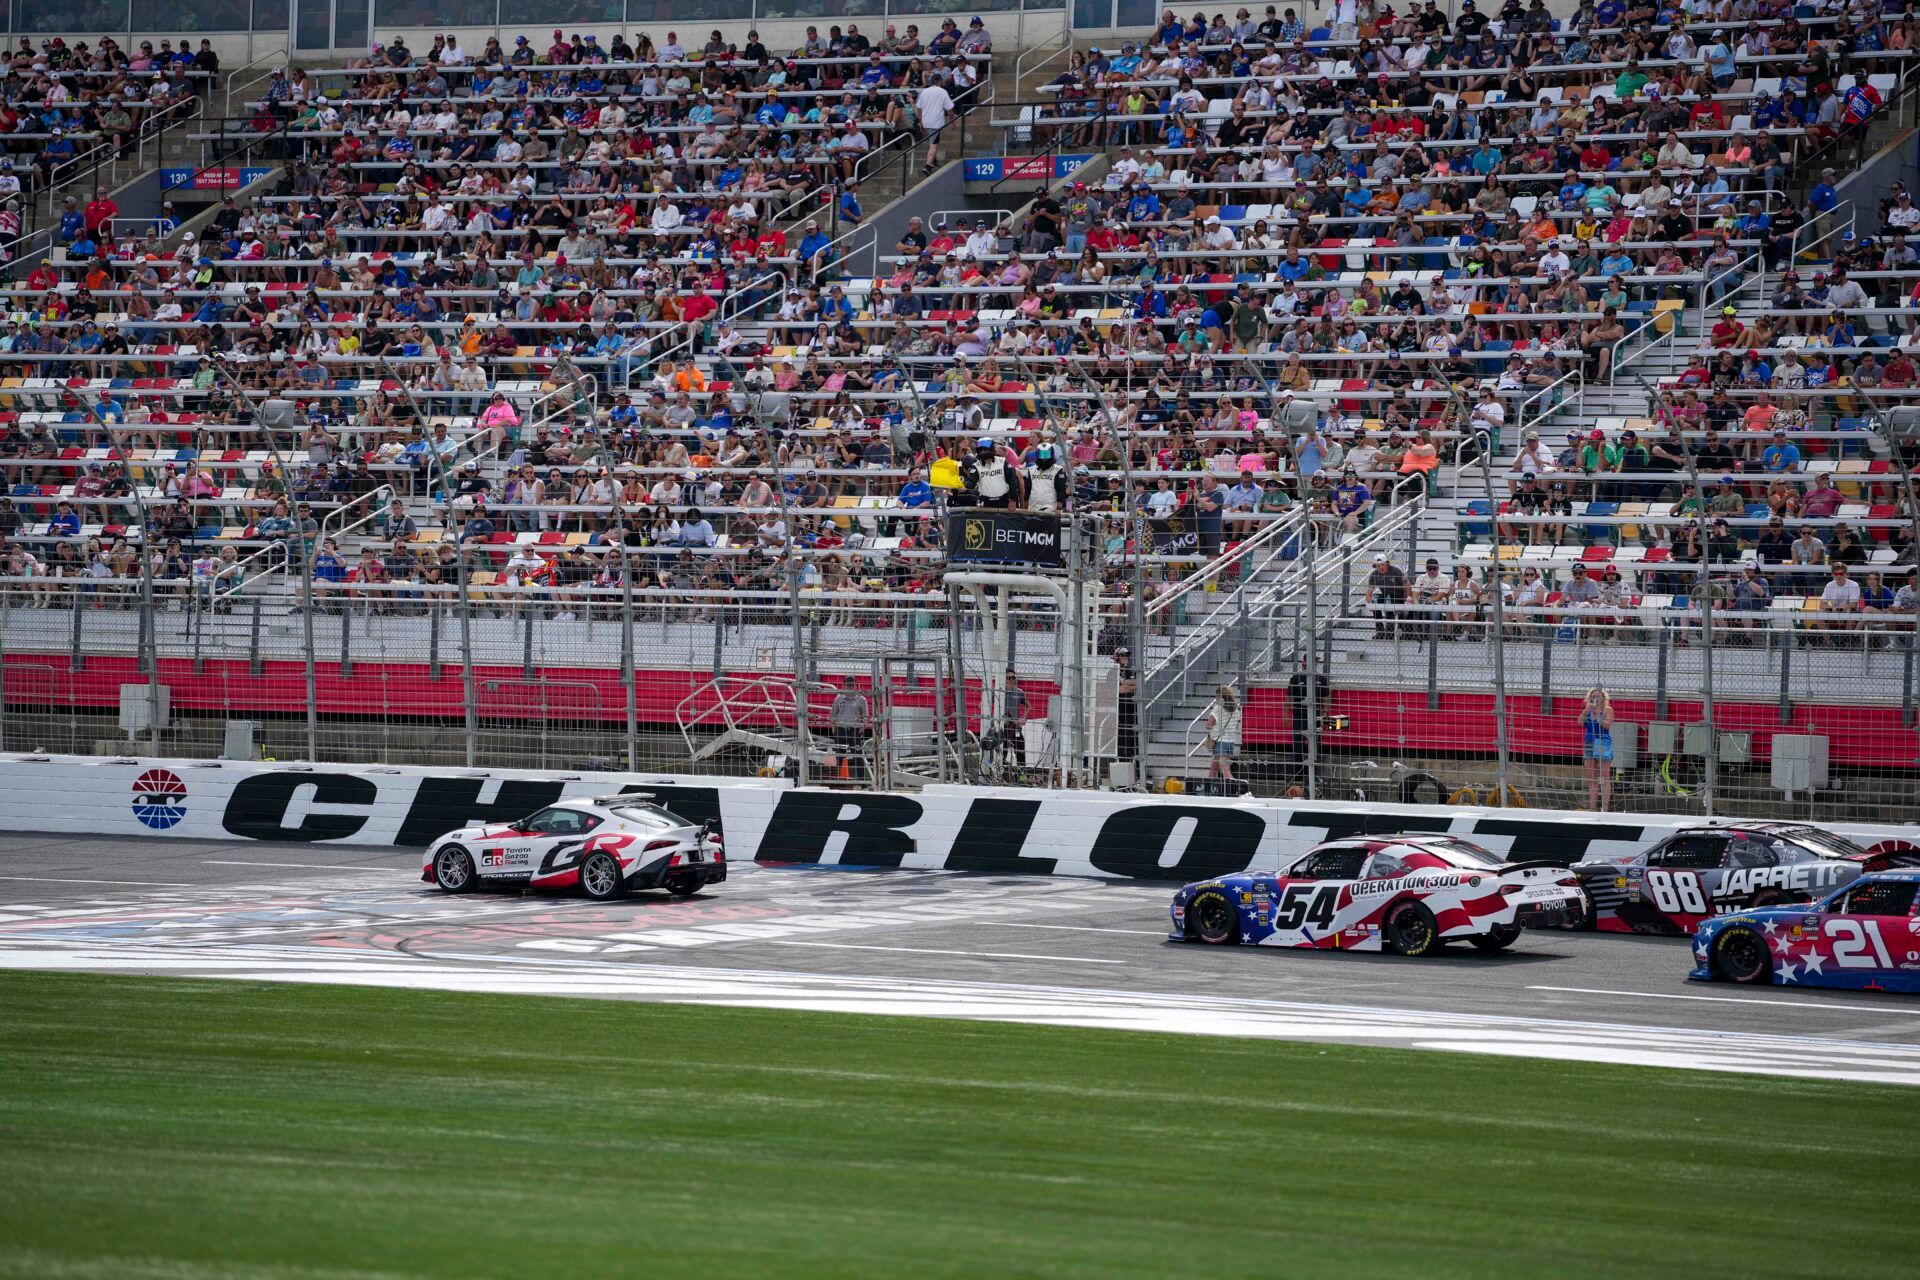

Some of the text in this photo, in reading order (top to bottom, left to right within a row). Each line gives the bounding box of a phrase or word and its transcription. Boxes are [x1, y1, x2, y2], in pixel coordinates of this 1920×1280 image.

[976, 164, 994, 175] 129
[1062, 160, 1081, 172] 128
[170, 173, 187, 184] 130
[996, 529, 1054, 546] BETMGM
[222, 771, 1645, 880] CHARLOTT
[482, 855, 503, 866] GR
[1351, 875, 1460, 896] OPERATION 300
[1647, 870, 1707, 914] 88
[1275, 886, 1341, 931] 54
[1541, 899, 1567, 910] TOYOTA
[1824, 919, 1895, 969] 21
